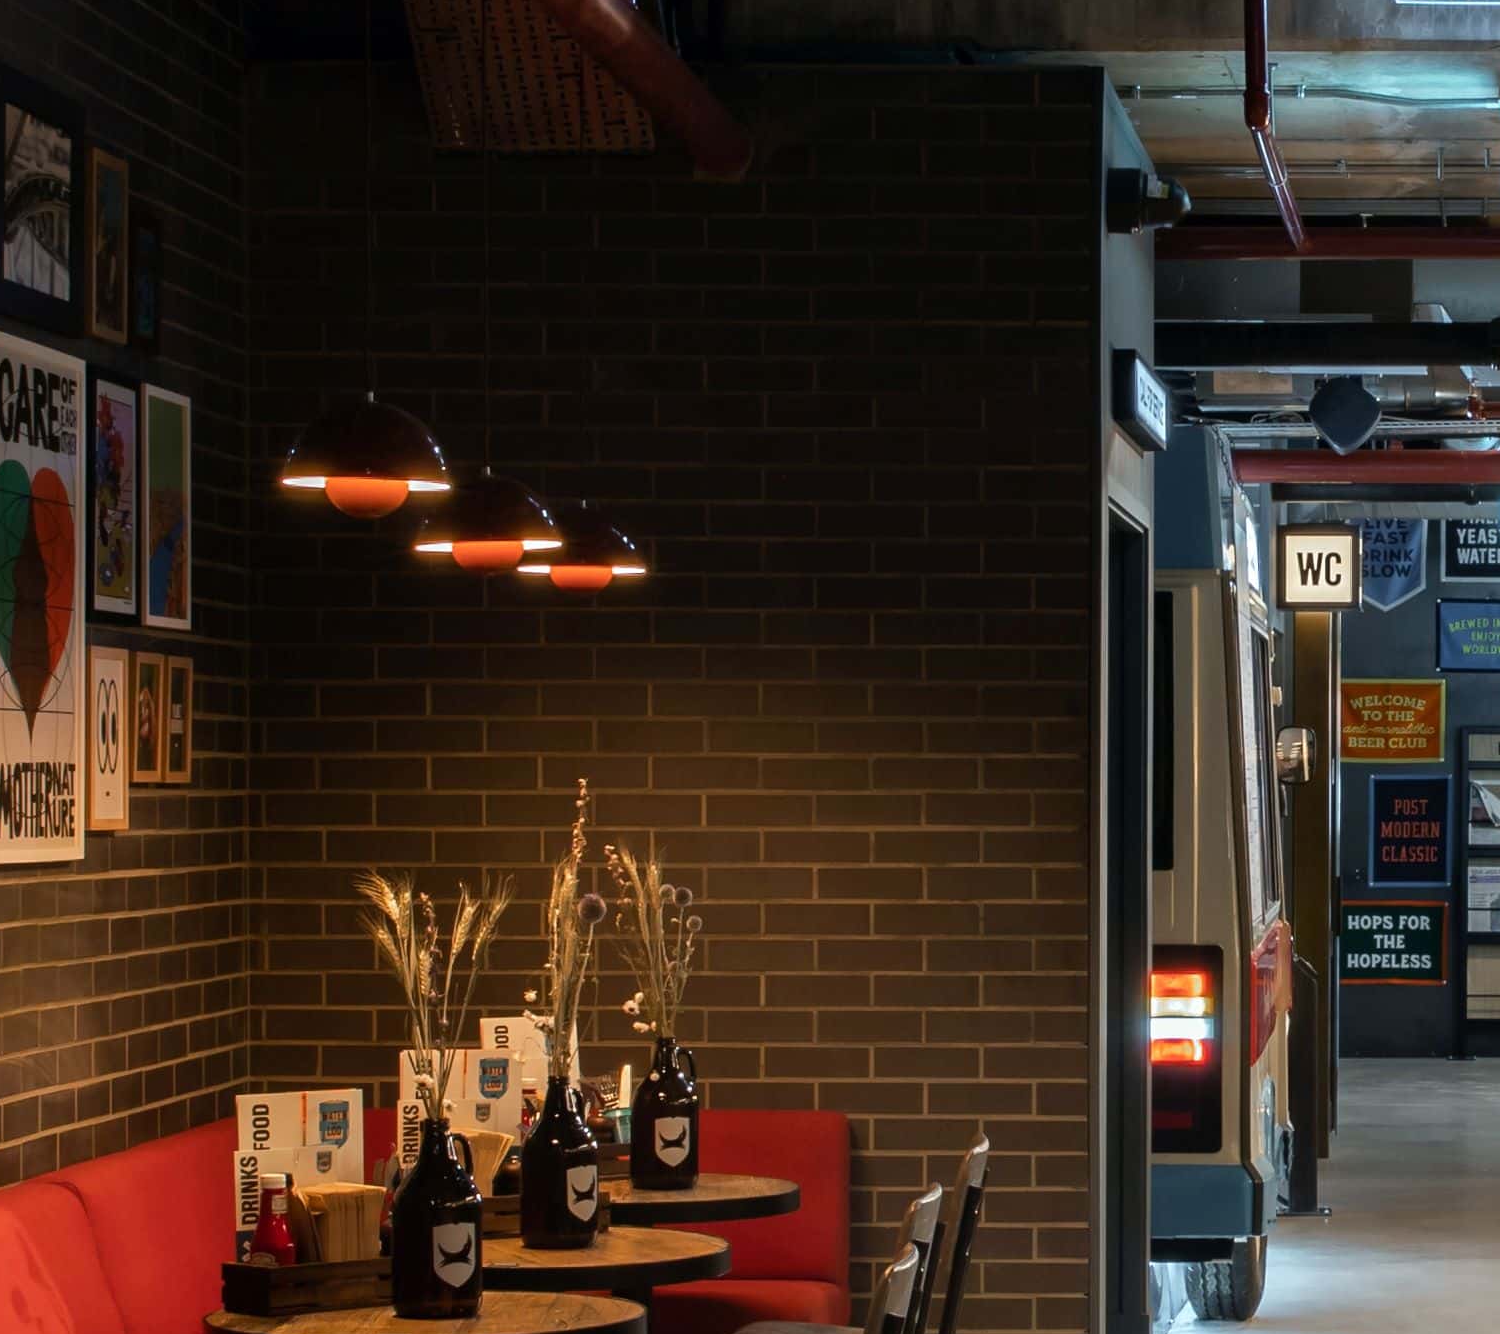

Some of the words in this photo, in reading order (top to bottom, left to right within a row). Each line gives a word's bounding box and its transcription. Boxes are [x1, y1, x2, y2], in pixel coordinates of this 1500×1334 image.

[61, 377, 78, 404] OF
[1364, 531, 1409, 544] FAST
[1297, 552, 1342, 586] WC
[1448, 618, 1489, 633] BREWED
[1350, 694, 1426, 711] WELCOME
[1361, 710, 1382, 721] TO
[1386, 710, 1415, 722] THE
[1348, 736, 1386, 749] BEER
[1388, 737, 1427, 748] CLUB
[1393, 799, 1428, 815] POST
[1380, 821, 1440, 838] MODERN
[1381, 845, 1439, 862] CLASSIC
[1347, 915, 1393, 930] HOPS
[1398, 915, 1431, 931] FOR
[1373, 934, 1405, 949] THE
[1347, 953, 1432, 969] HOPELESS
[252, 1104, 271, 1150] FOOD
[402, 1104, 421, 1165] DRINKS
[240, 1155, 260, 1226] DRINKS
